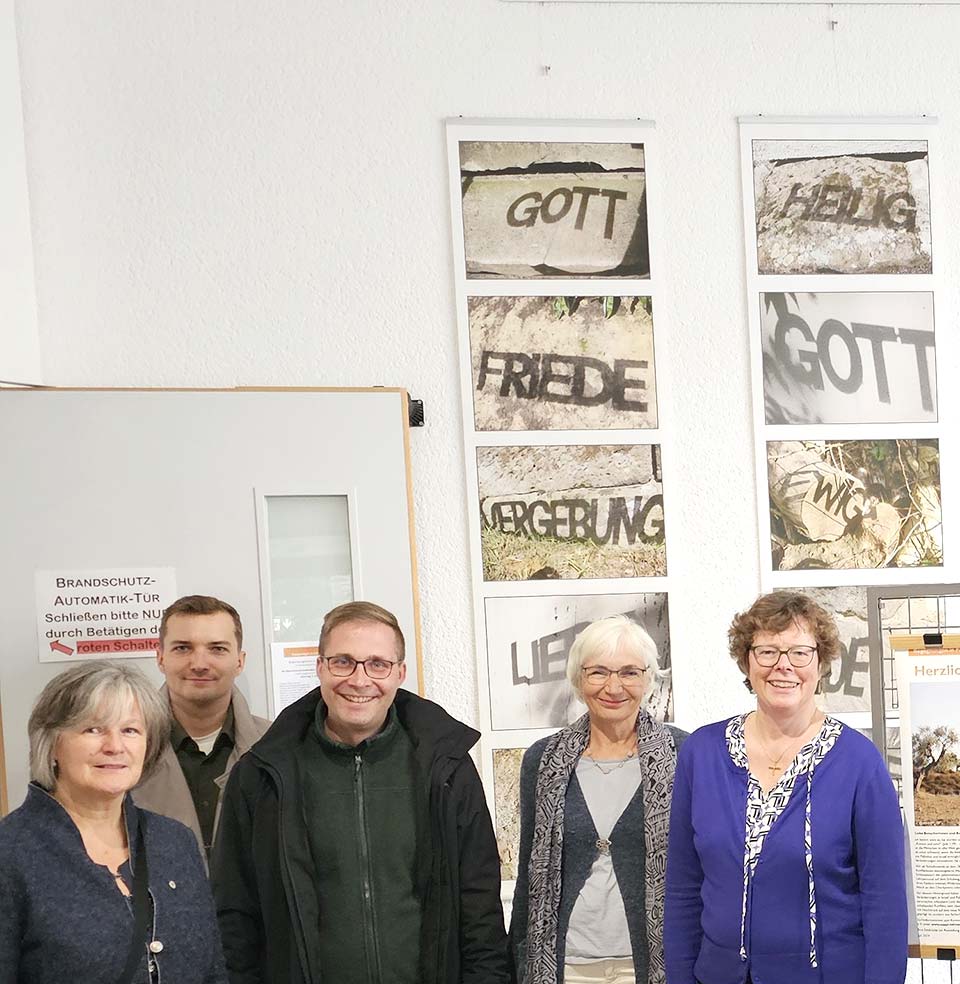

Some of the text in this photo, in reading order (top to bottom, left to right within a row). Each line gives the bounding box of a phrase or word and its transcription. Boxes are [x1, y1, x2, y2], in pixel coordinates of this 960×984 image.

[506, 186, 627, 240] GOTT
[779, 182, 918, 232] HEILIG
[774, 313, 935, 412] GOTT
[476, 350, 649, 412] FRIEDE
[480, 494, 665, 546] VERGEBUNG
[56, 576, 156, 588] BRANDSCHUTZ-
[54, 593, 160, 606] AUTOMATIK-TÜR
[45, 611, 107, 623] Schließen
[110, 611, 139, 621] bitte
[45, 625, 161, 638] durch Betätigen d
[77, 640, 160, 652] roten Schalte
